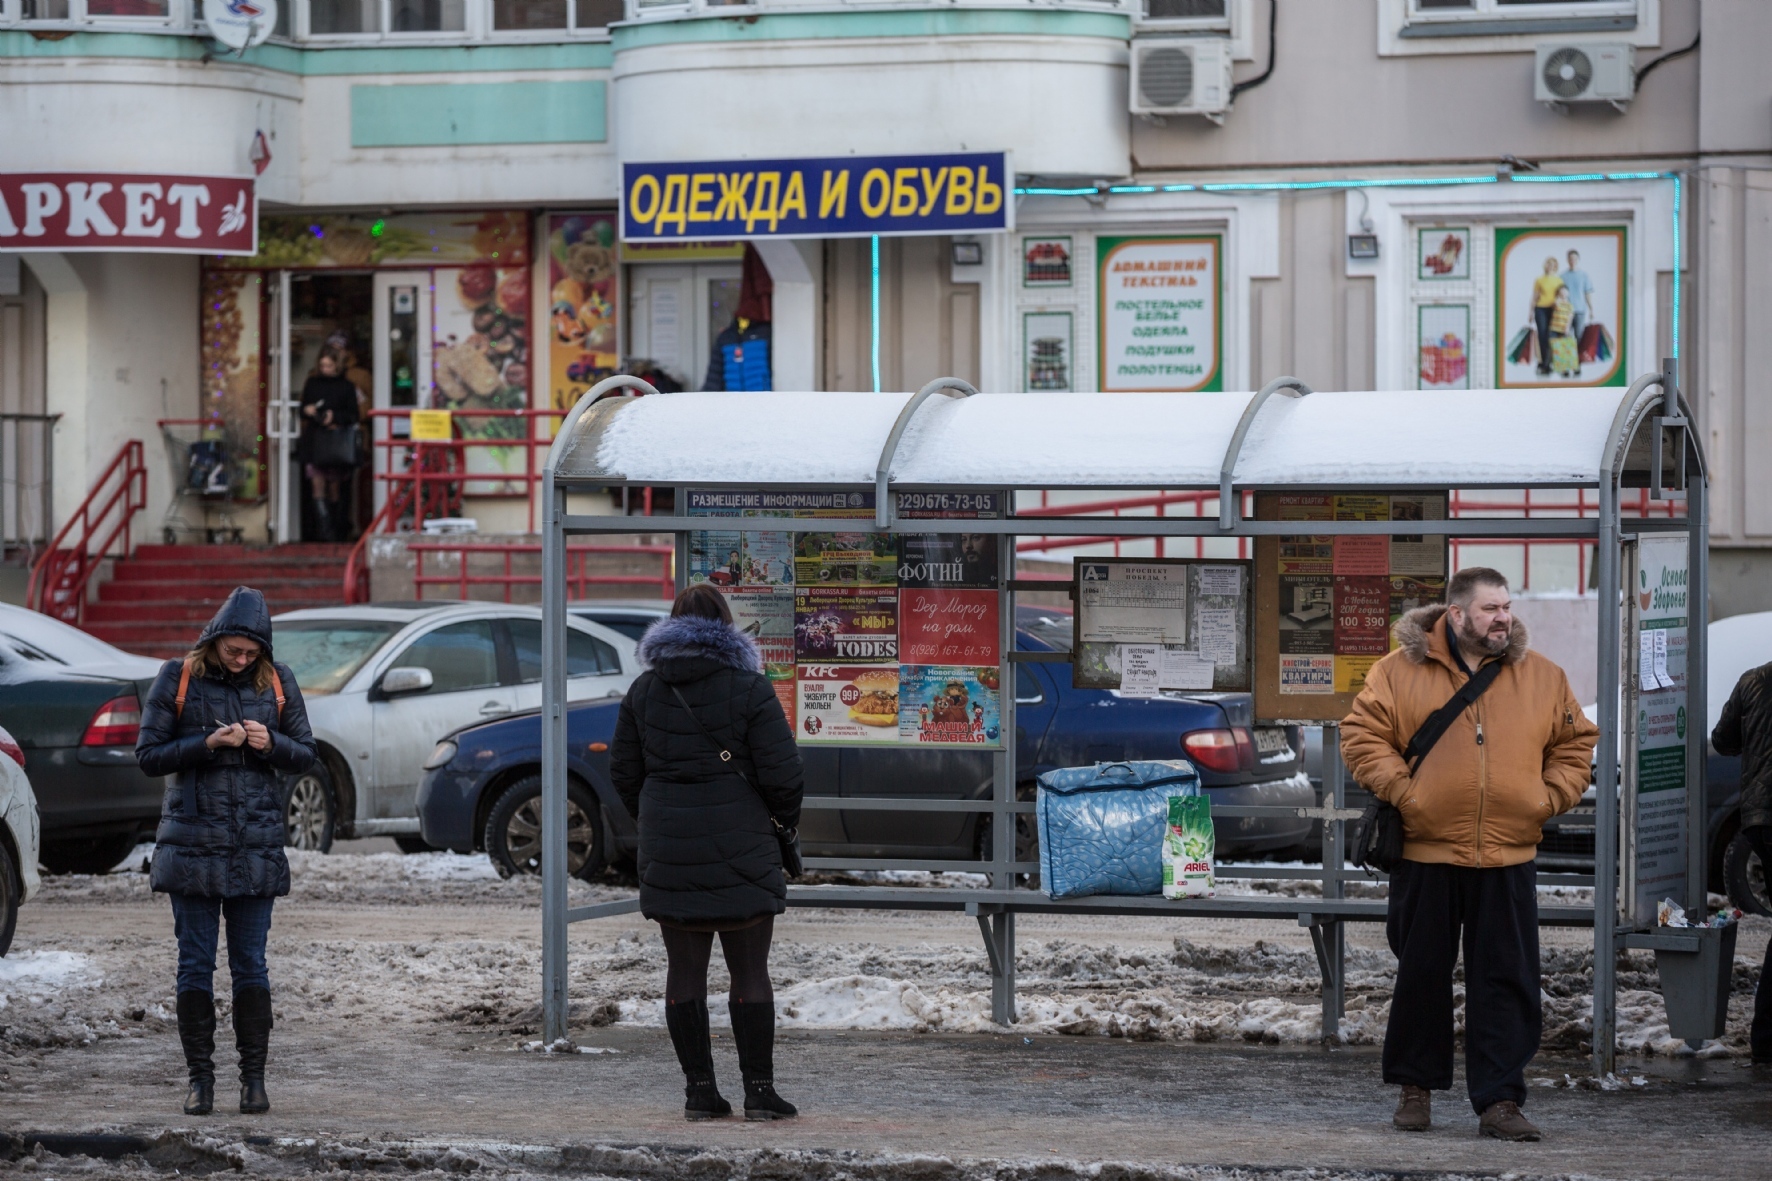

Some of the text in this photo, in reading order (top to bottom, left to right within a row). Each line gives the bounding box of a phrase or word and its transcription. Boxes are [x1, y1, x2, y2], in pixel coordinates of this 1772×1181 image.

[629, 165, 1003, 235] ОДЕЖДА И ОБУВЬ
[1113, 258, 1208, 273] ДОМАШНИЙ
[1122, 275, 1198, 288] ТЕКСТИЛЬ
[1115, 299, 1204, 310] ПОСТЕЛЬНОЕ
[1135, 311, 1180, 321] БЕЛЬЕ
[1132, 326, 1188, 337] ОДЕЯЛА
[1125, 345, 1195, 357] ПОДУШКИ
[1117, 364, 1203, 376] ПОЛОТЕНЦА
[692, 494, 760, 508] РАЗМЕЩЕНИЕ
[763, 494, 832, 508] ИНФОРМАЦИИ
[1279, 496, 1300, 504] РЕМОНТ
[897, 556, 964, 582] ФОТИЙ
[1661, 565, 1687, 587] Основа
[795, 596, 806, 606] 19
[838, 596, 855, 604] Дворец
[855, 596, 877, 604] Культуры
[1344, 596, 1380, 605] С Новым
[1653, 585, 1686, 613] Здоровья
[912, 595, 988, 620] Дед Мороз
[1339, 605, 1385, 616] 2017 годом
[852, 615, 895, 629] «МЫ»
[922, 622, 942, 633] на
[1339, 617, 1385, 627] 100 390
[833, 641, 898, 657] TODES
[1282, 658, 1332, 667] ЖИЛСТРОЙ-СЕРВИС
[804, 666, 840, 678] KFC
[927, 669, 975, 677] Новогодние
[1282, 672, 1331, 681] КВАРТИРЫ
[804, 684, 825, 692] ВУАЛЯ!
[804, 693, 837, 701] ЧИЗБУРГЕР
[804, 702, 832, 710] ЖЮЛЬЕН
[922, 721, 982, 732] МАШИ И
[919, 732, 985, 743] МЕДВЕДЯ
[1184, 862, 1211, 872] ARIEL
